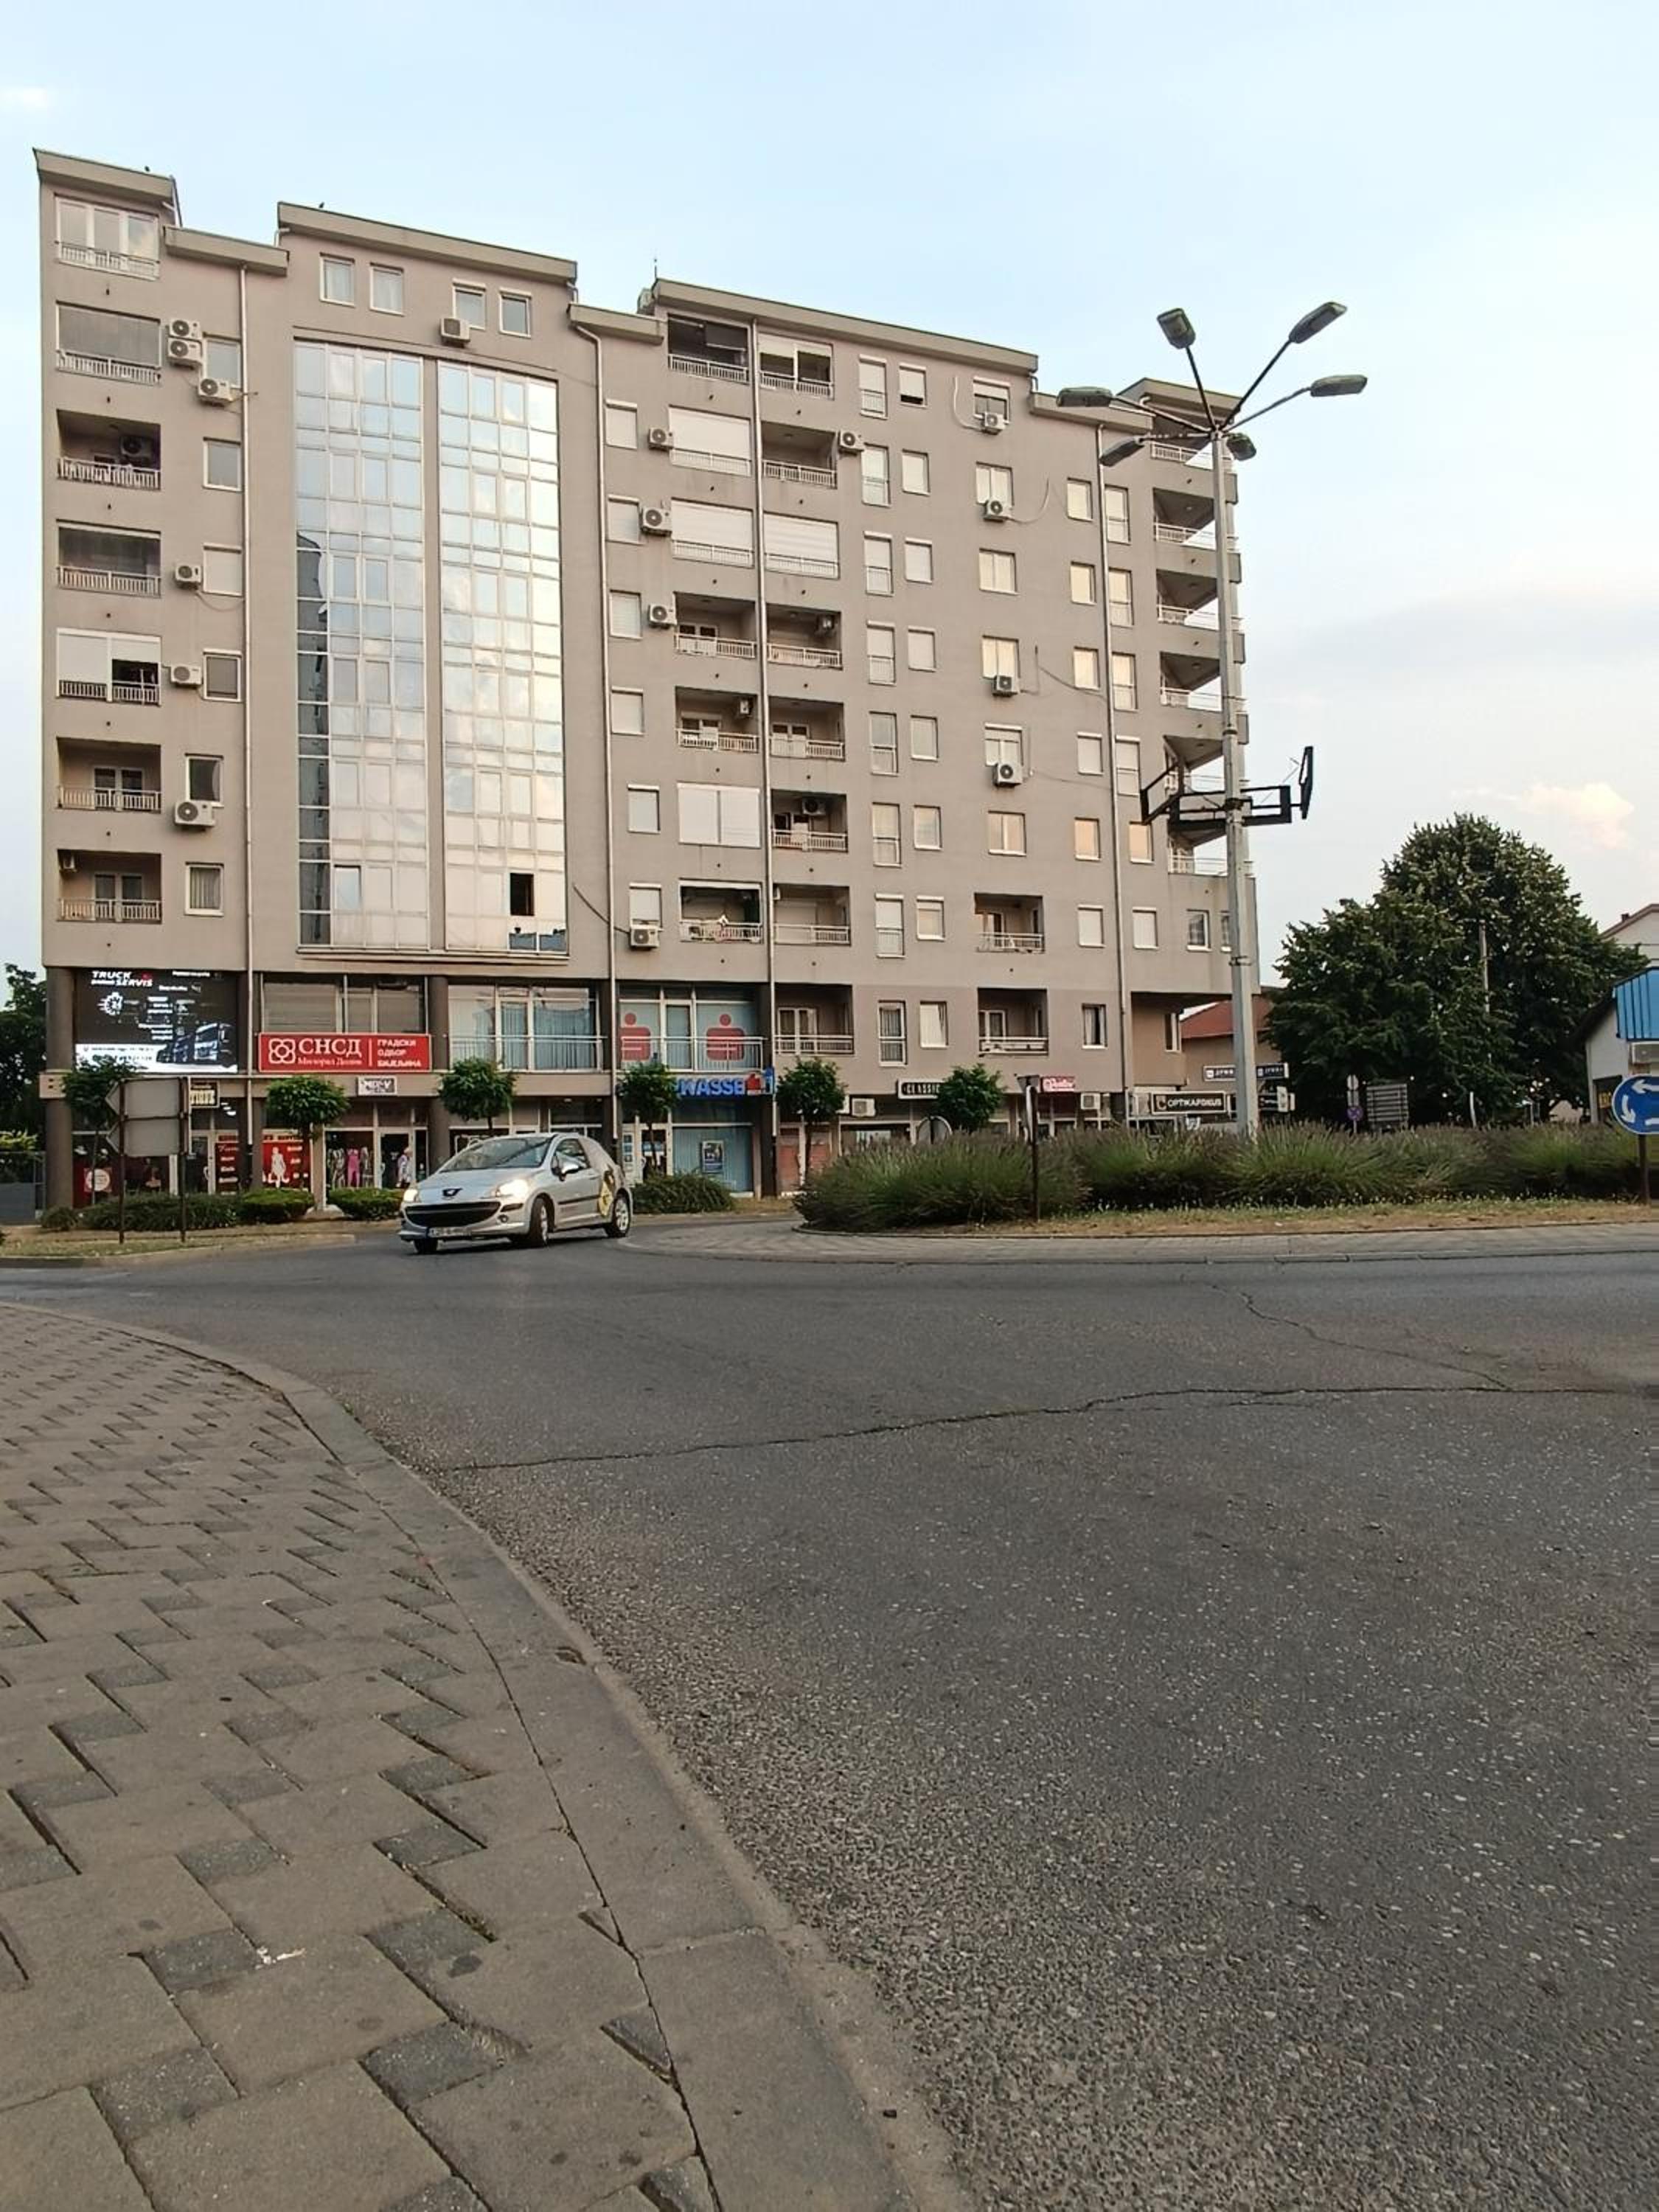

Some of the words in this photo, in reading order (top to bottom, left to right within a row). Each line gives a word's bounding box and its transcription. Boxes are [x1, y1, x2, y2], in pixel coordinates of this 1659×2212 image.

[91, 970, 132, 979] TRUCK
[116, 978, 153, 987] SERVIS
[298, 1038, 362, 1057] СНСД
[377, 1039, 417, 1047] ГРАДСКИ
[377, 1048, 407, 1057] ОДБОР
[678, 1077, 745, 1096] KASSE
